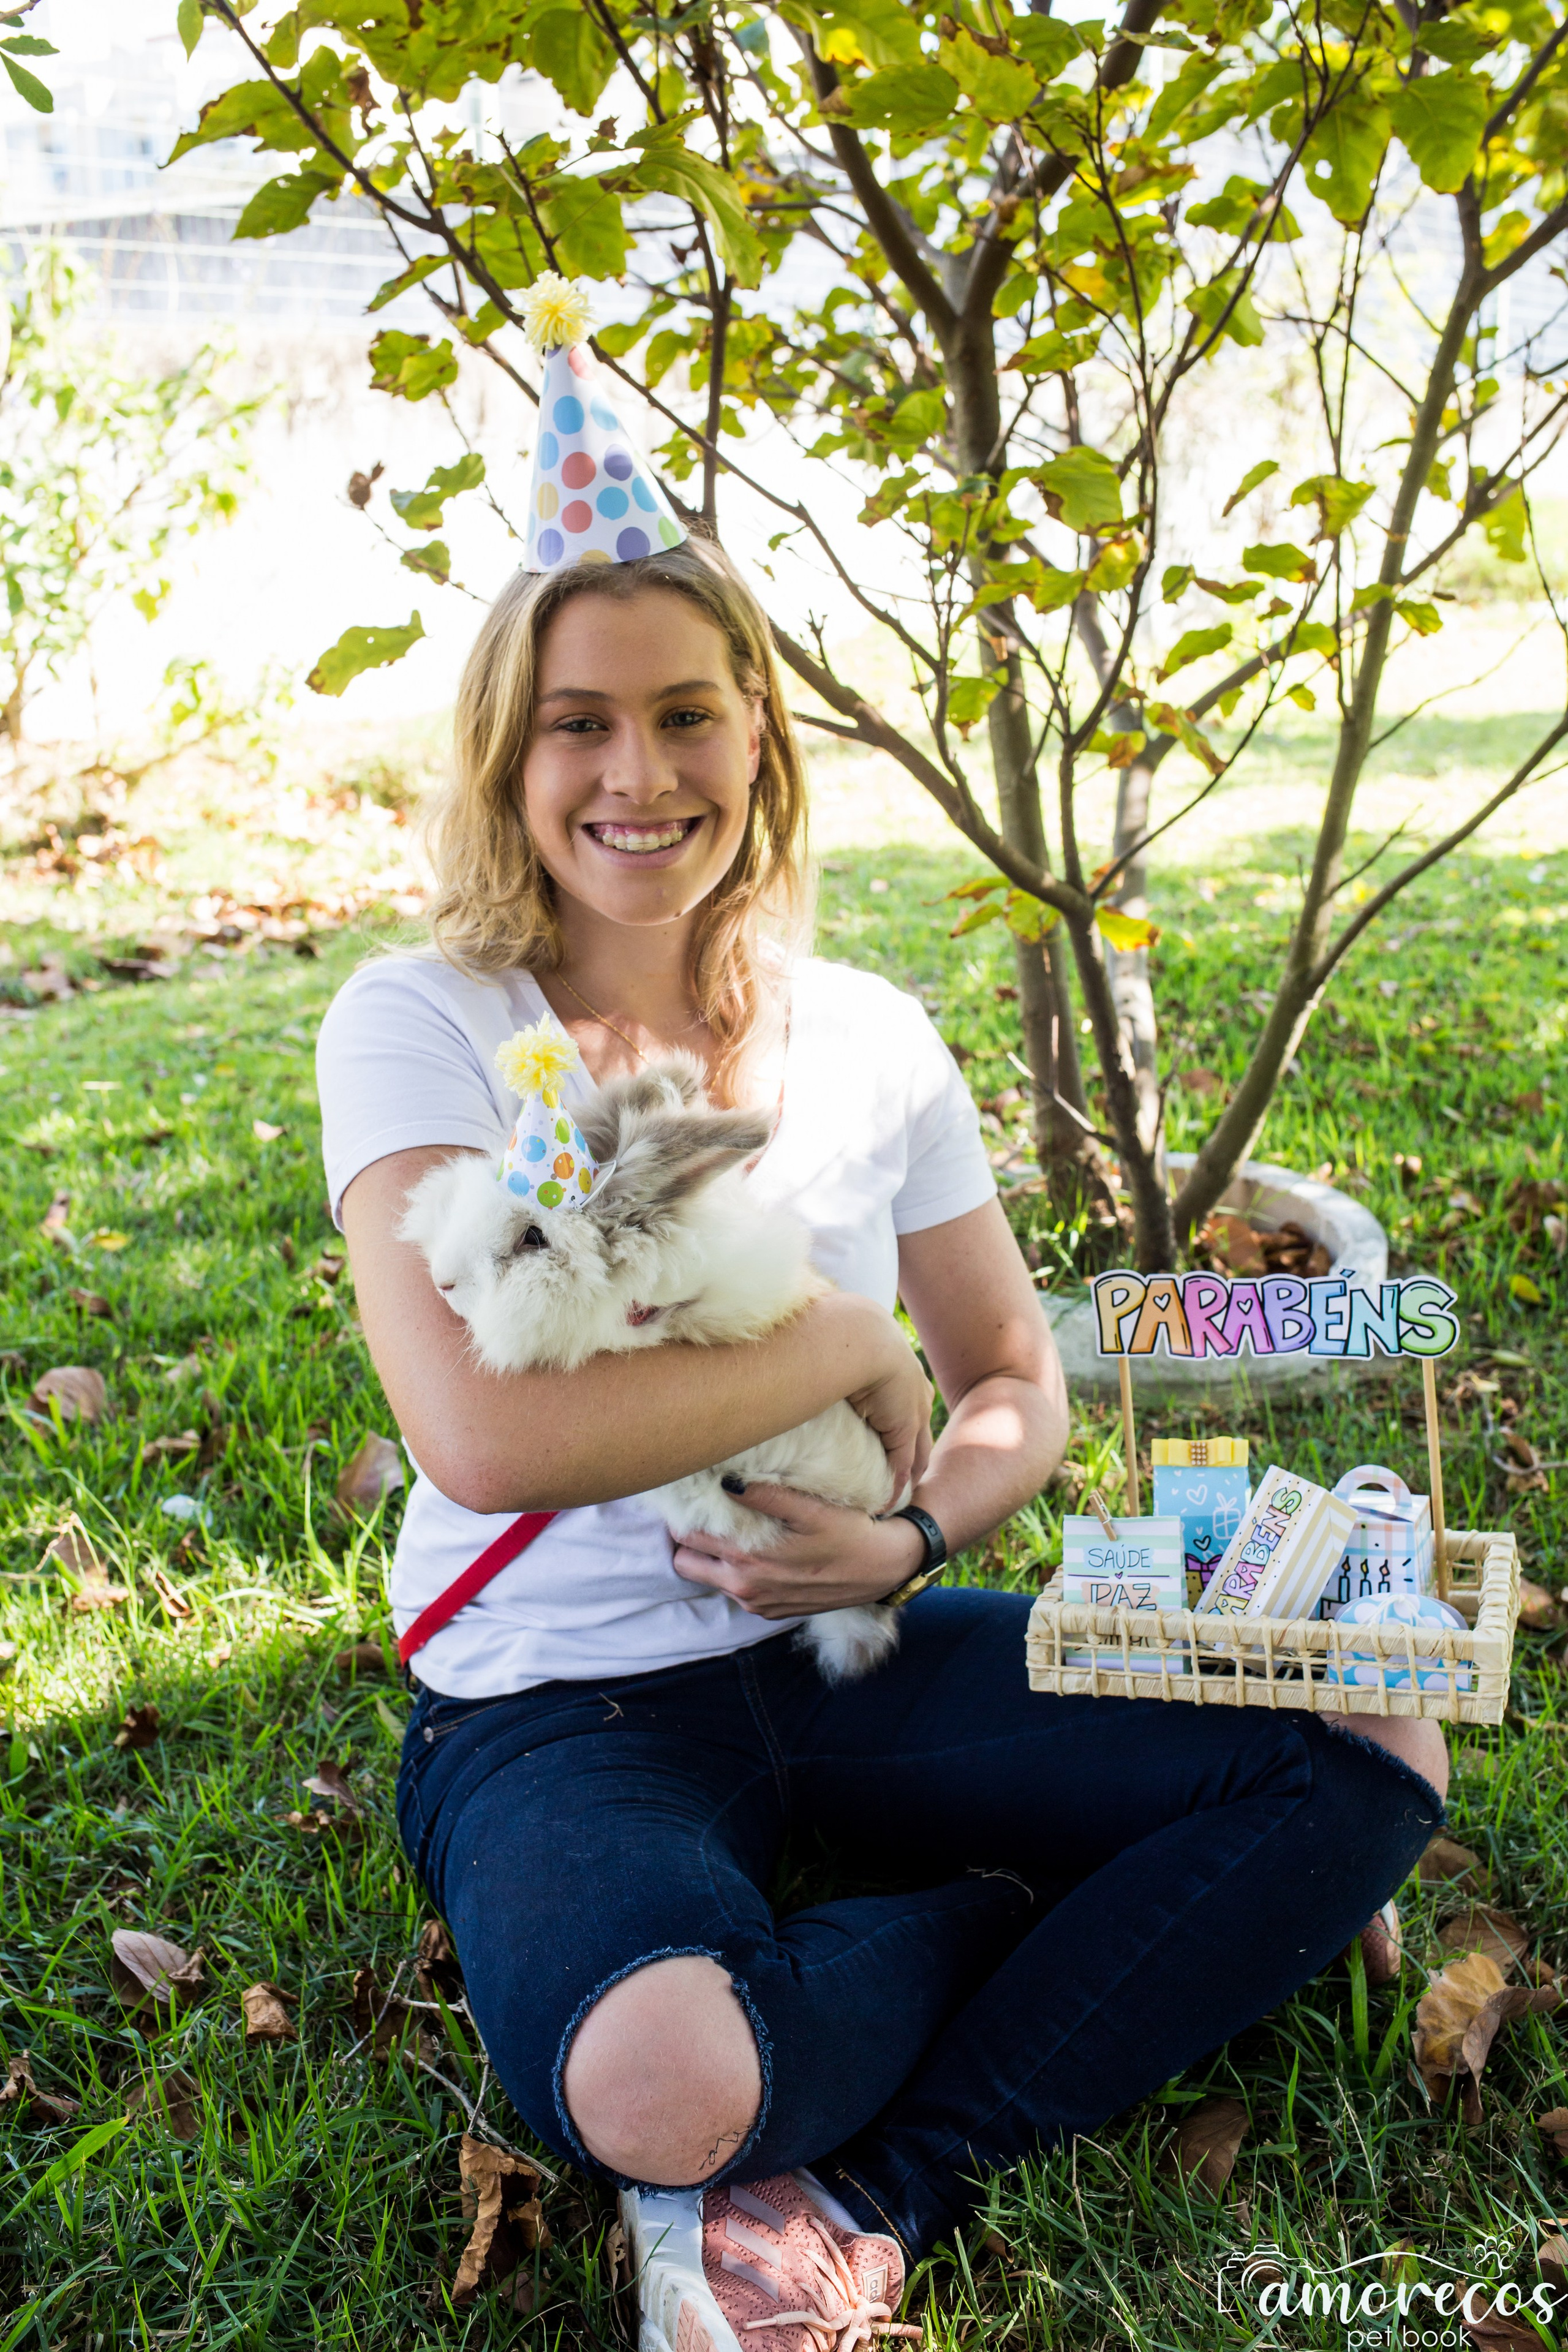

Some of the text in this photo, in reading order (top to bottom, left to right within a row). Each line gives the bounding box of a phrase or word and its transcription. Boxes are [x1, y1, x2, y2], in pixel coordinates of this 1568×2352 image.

[1094, 1268, 1457, 1357] PARABÉNS
[1088, 1544, 1151, 1569] SAÚDE
[1090, 1583, 1157, 1611] PAZ
